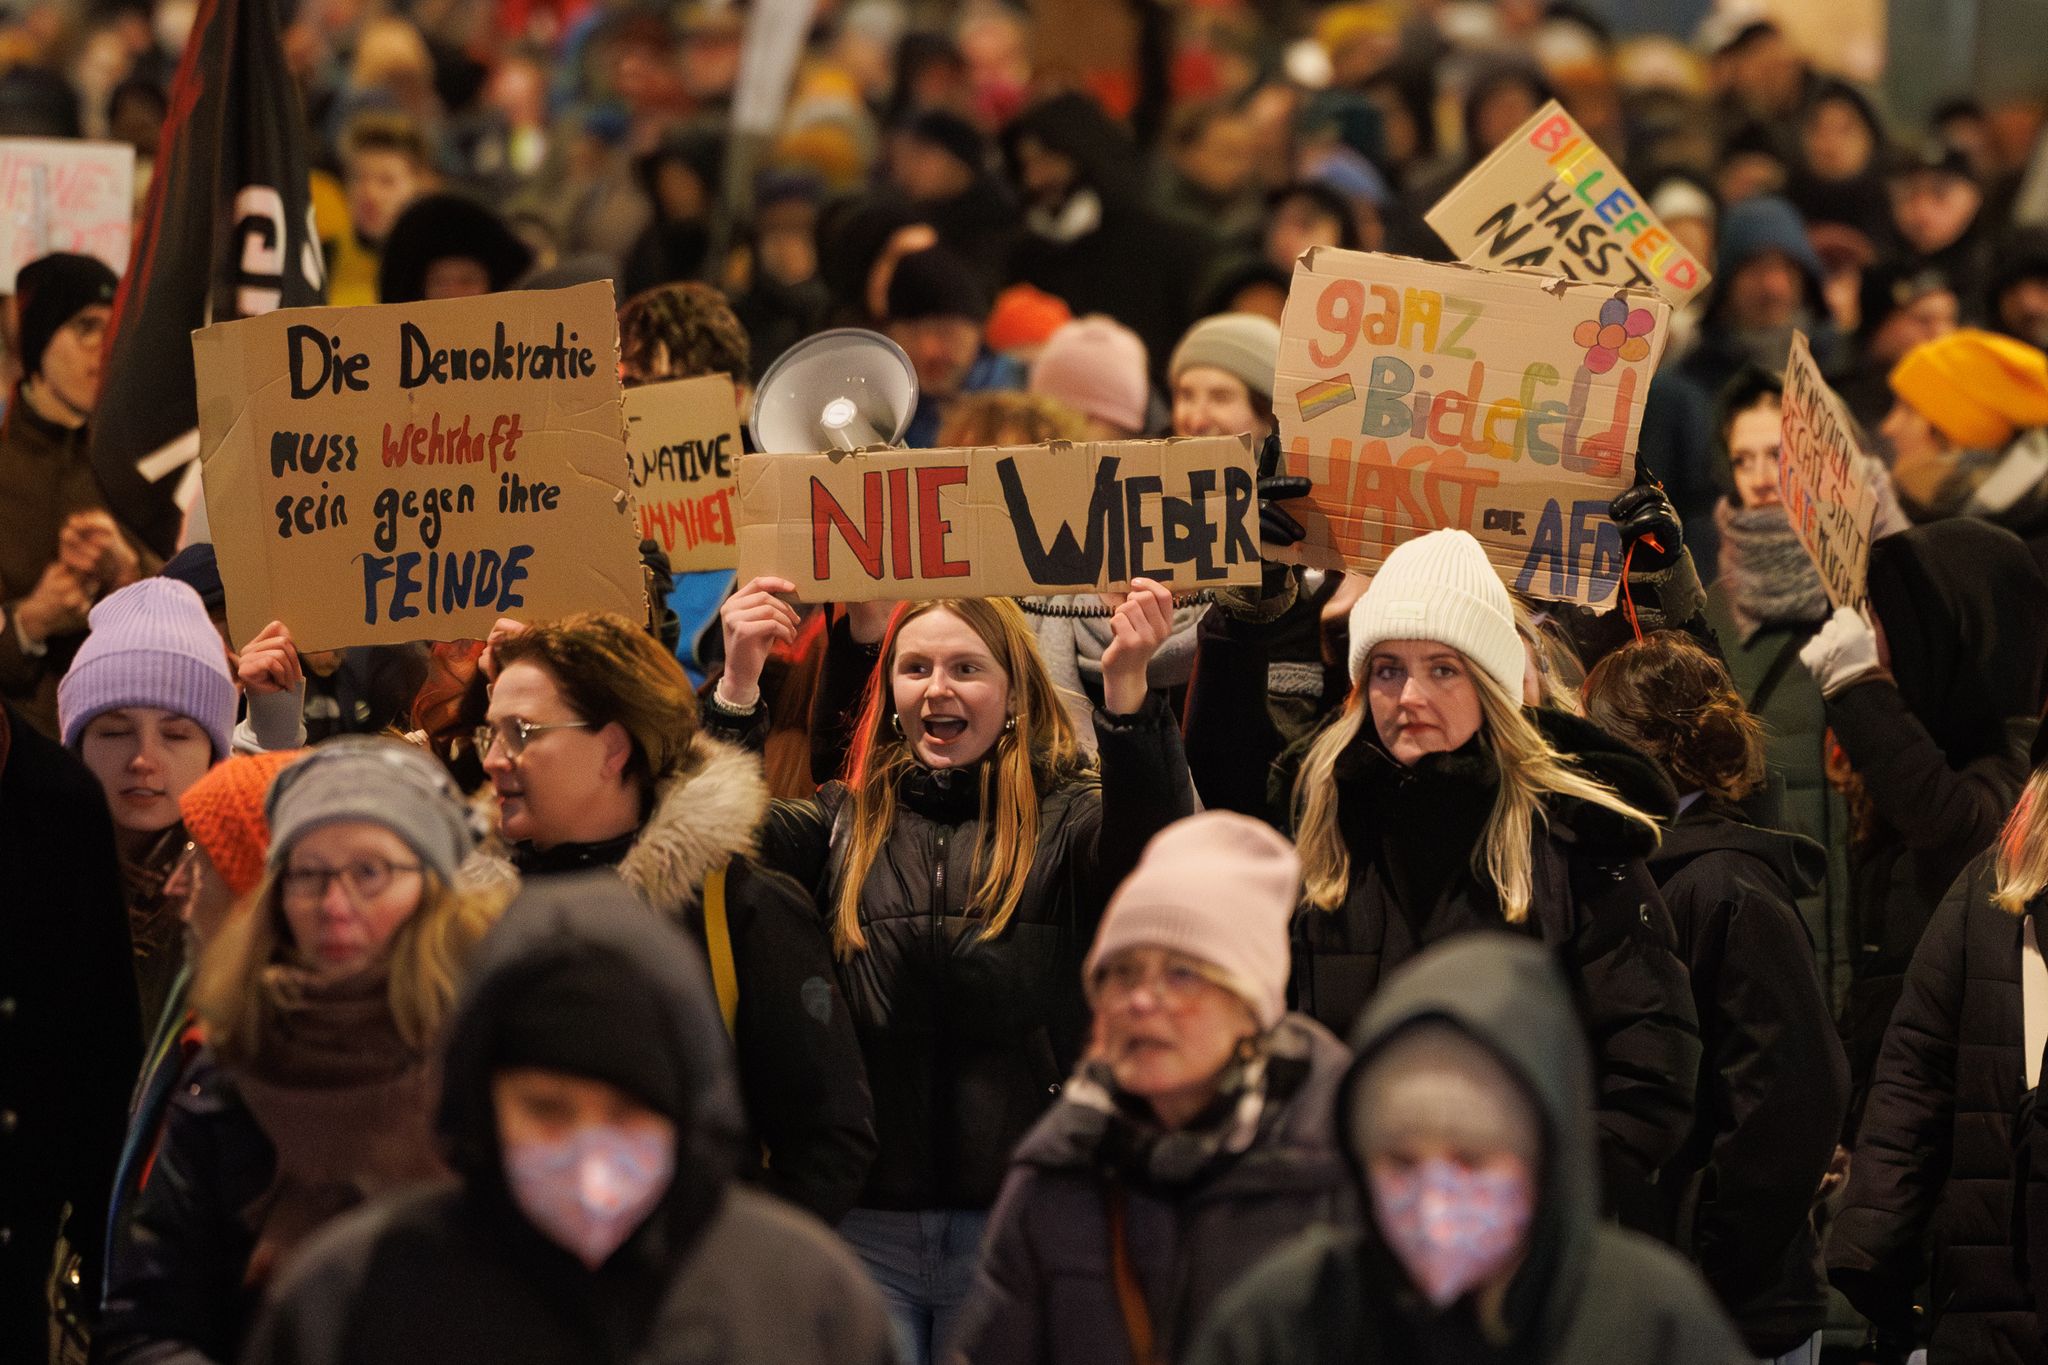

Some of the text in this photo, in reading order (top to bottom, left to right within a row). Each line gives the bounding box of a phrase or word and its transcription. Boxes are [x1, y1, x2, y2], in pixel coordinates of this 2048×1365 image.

[1474, 203, 1580, 280] NA
[1524, 180, 1654, 288] HASST
[287, 324, 371, 400] Die
[1308, 278, 1486, 369] ganz
[1361, 356, 1637, 477] Bielefeld
[275, 471, 561, 552] sein gegen ihre
[810, 455, 1261, 588] NIE WIEDER
[1287, 437, 1500, 562] HASST
[1482, 508, 1527, 535] DIE
[353, 545, 536, 626] FEINDE
